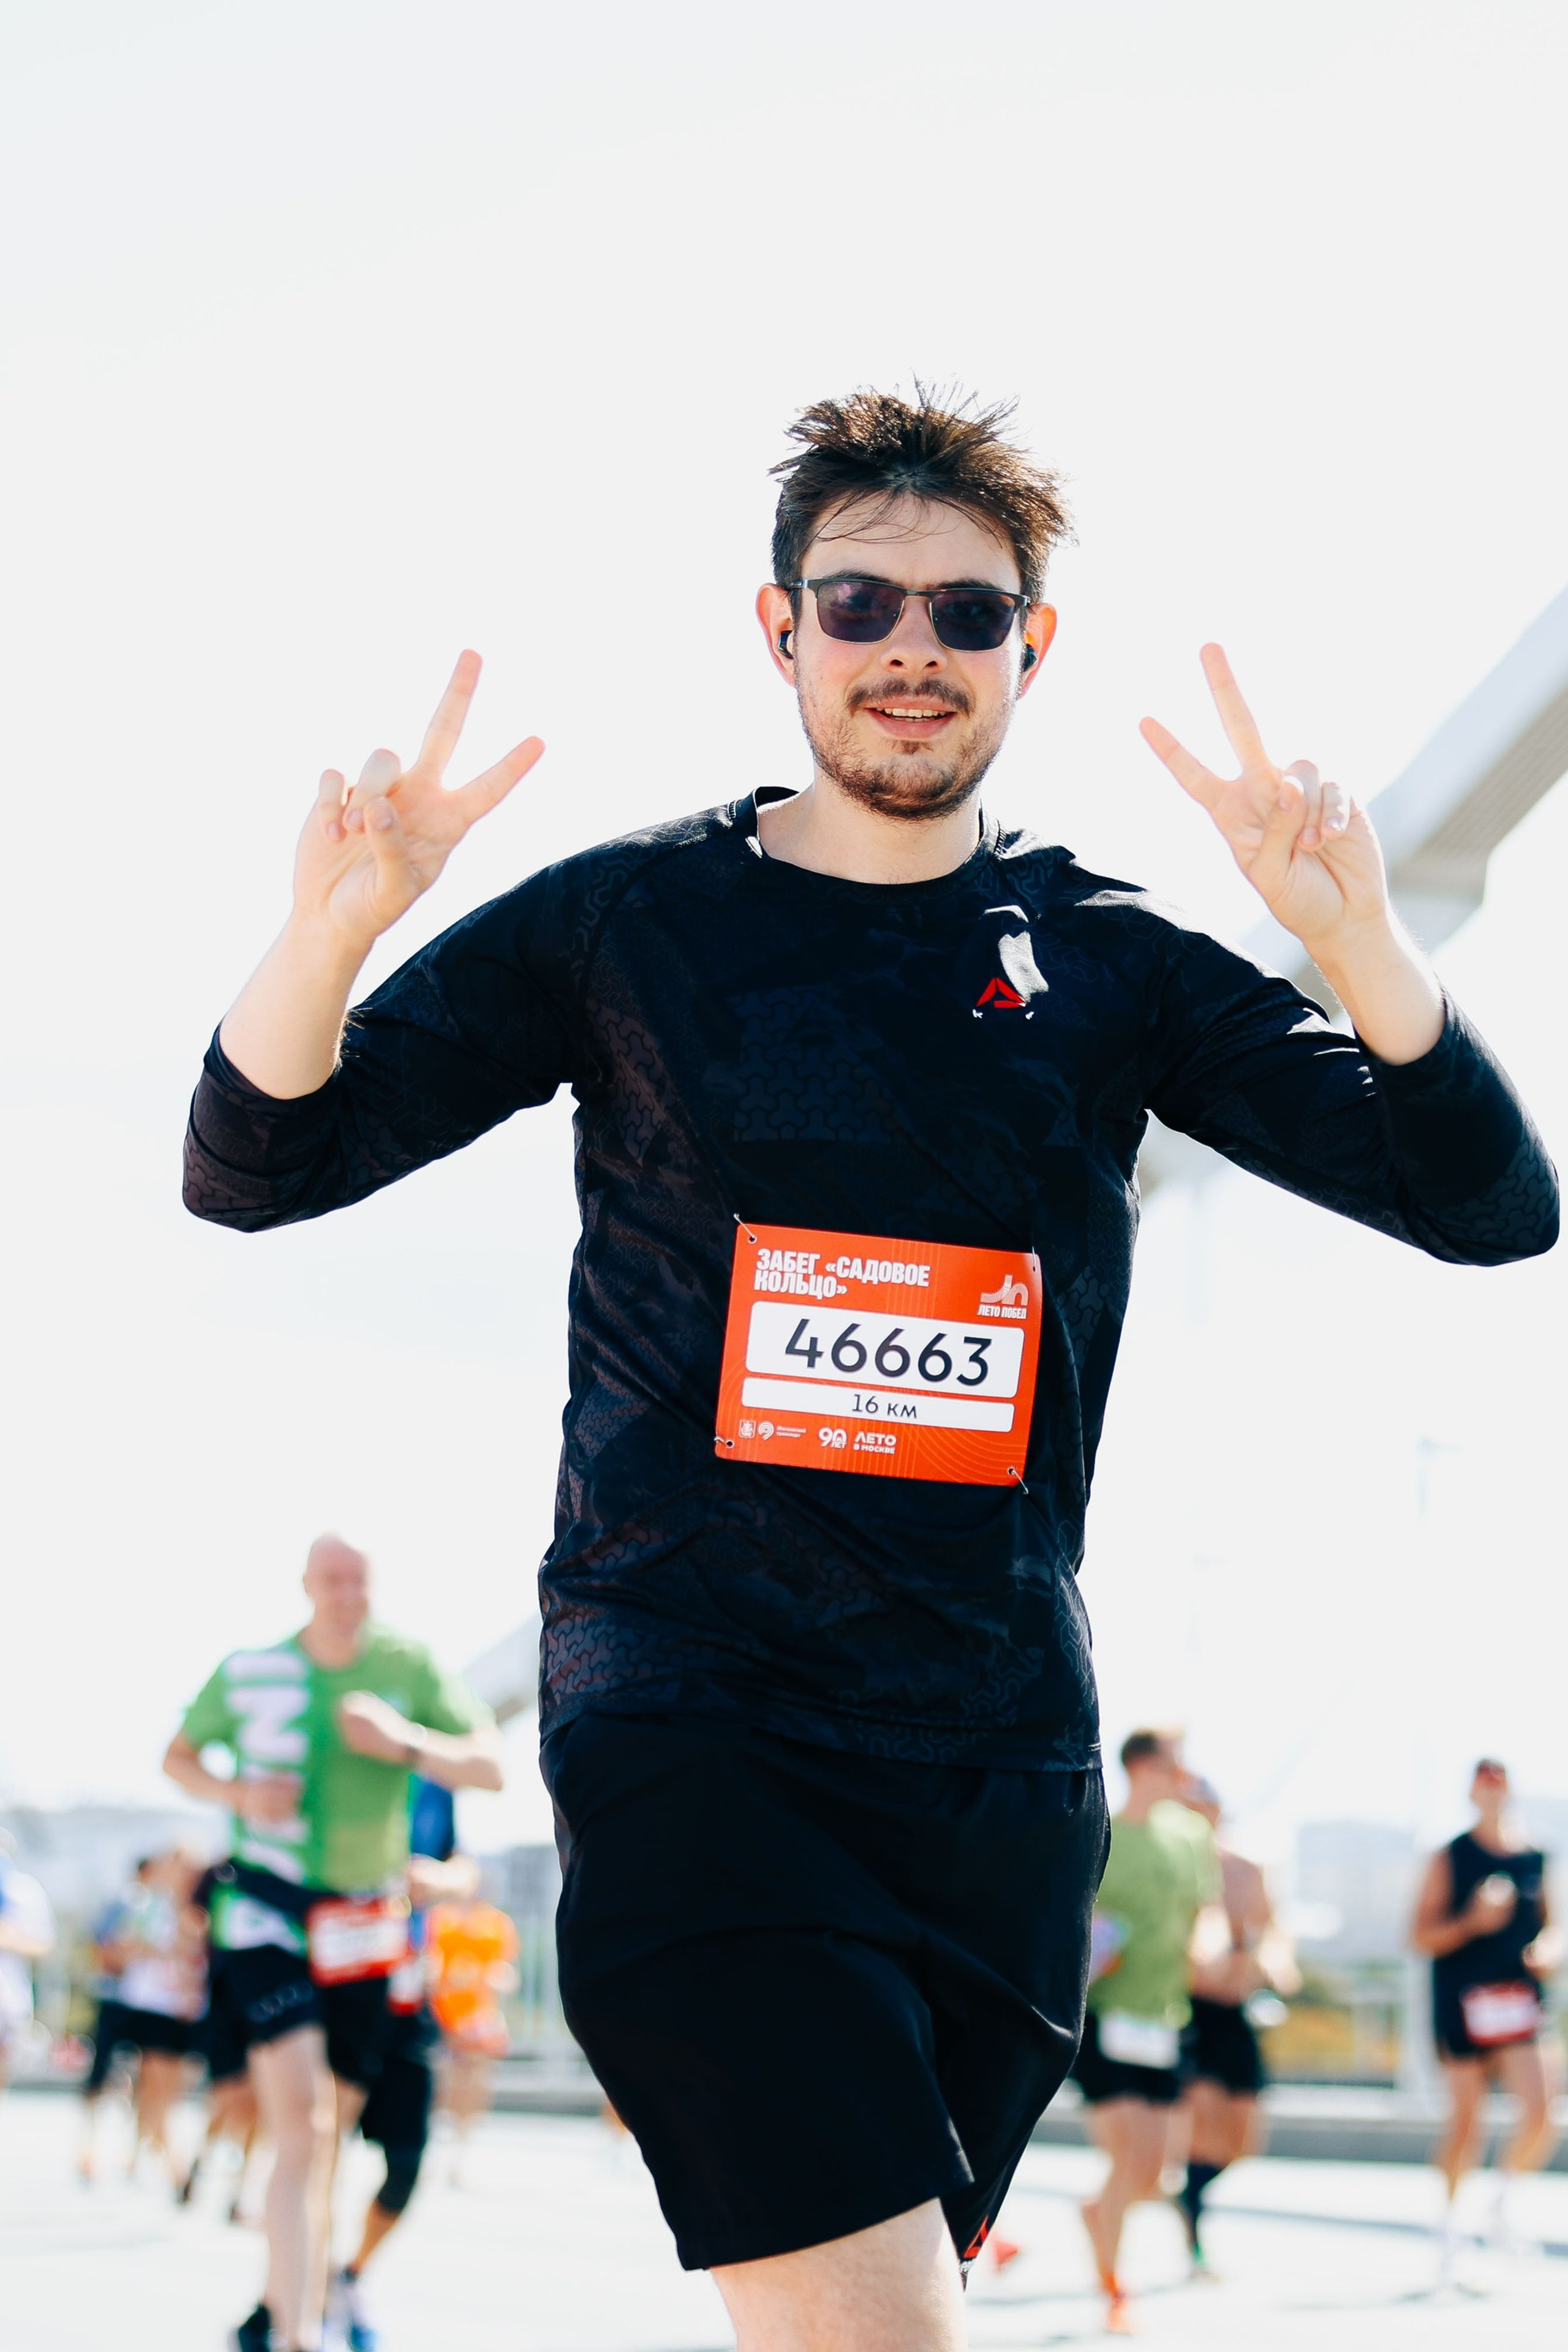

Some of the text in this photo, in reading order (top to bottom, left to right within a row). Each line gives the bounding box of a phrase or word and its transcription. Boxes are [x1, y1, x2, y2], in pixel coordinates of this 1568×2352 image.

[756, 1249, 931, 1287] ЗАБЕГ «САДОВОЕ
[753, 1270, 848, 1300] КОЛЬЦО»
[977, 1305, 1027, 1319] ЛЕТО ПОБЕД
[785, 1318, 992, 1386] 46663
[851, 1393, 878, 1413] 16
[855, 1431, 897, 1447] ЛЕТО
[861, 1446, 895, 1455] МОСКВЕ
